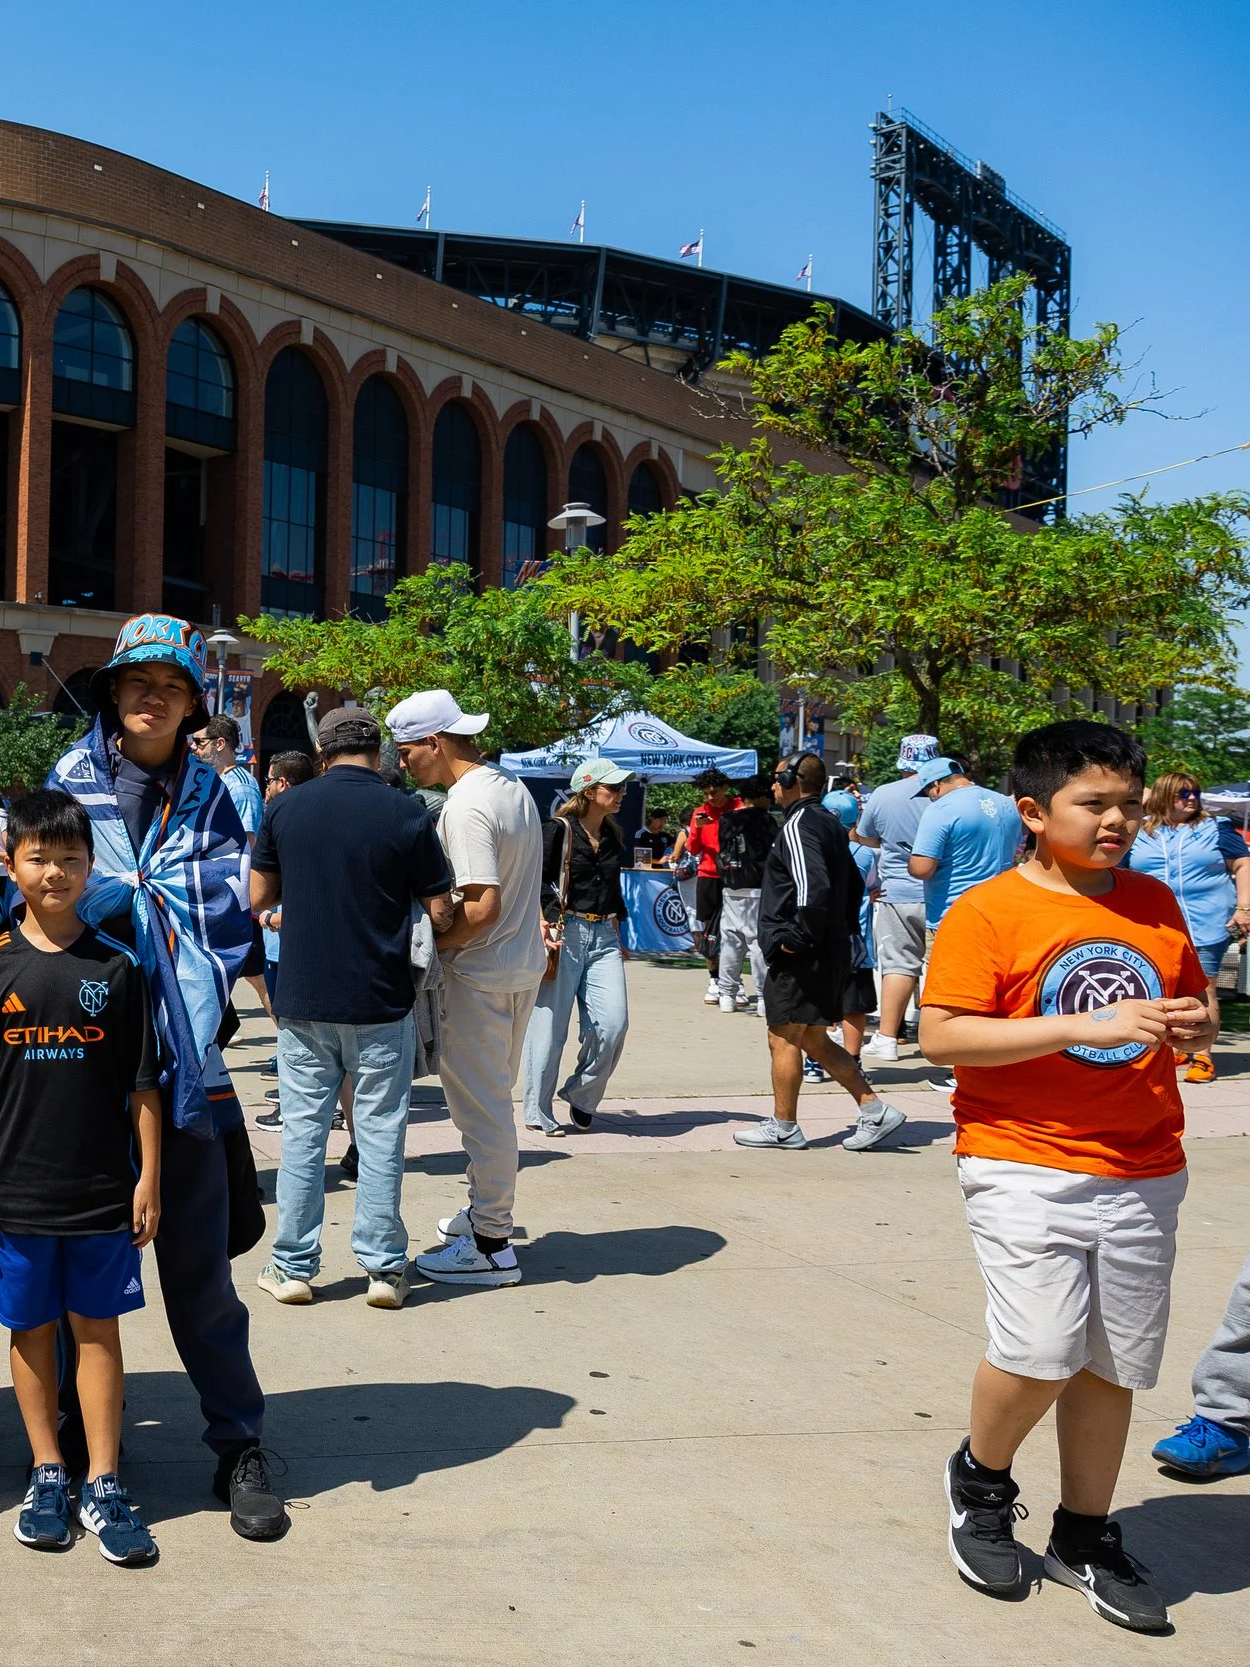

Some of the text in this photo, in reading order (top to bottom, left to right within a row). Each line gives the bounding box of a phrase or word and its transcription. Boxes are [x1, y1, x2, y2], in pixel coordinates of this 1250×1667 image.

[116, 612, 192, 655] YORK
[228, 674, 251, 683] SEAVER
[640, 752, 661, 767] NEW
[662, 753, 686, 768] YORK
[686, 754, 704, 768] CITY
[1059, 946, 1147, 971] NEW YORK CITY
[3, 1026, 105, 1045] ETIHAD
[24, 1047, 84, 1060] AIRWAYS
[1071, 1042, 1144, 1061] OTBALL CLU
